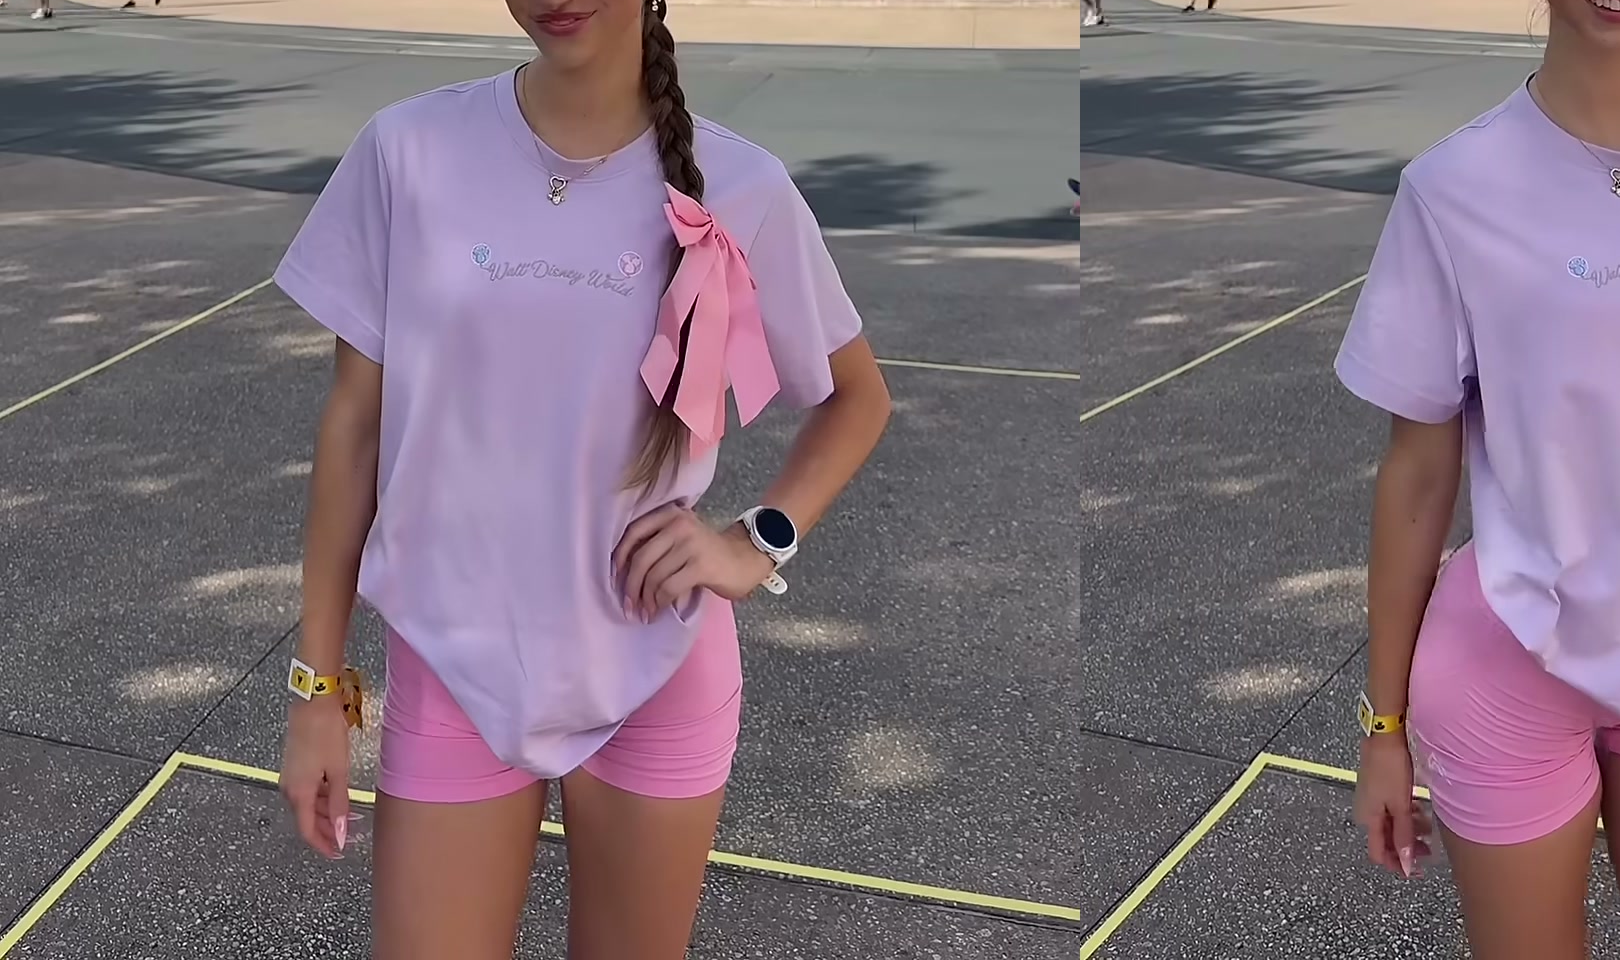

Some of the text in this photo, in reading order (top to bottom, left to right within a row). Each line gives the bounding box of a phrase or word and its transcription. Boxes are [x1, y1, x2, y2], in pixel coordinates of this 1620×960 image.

[488, 260, 634, 297] Walt Disney World
